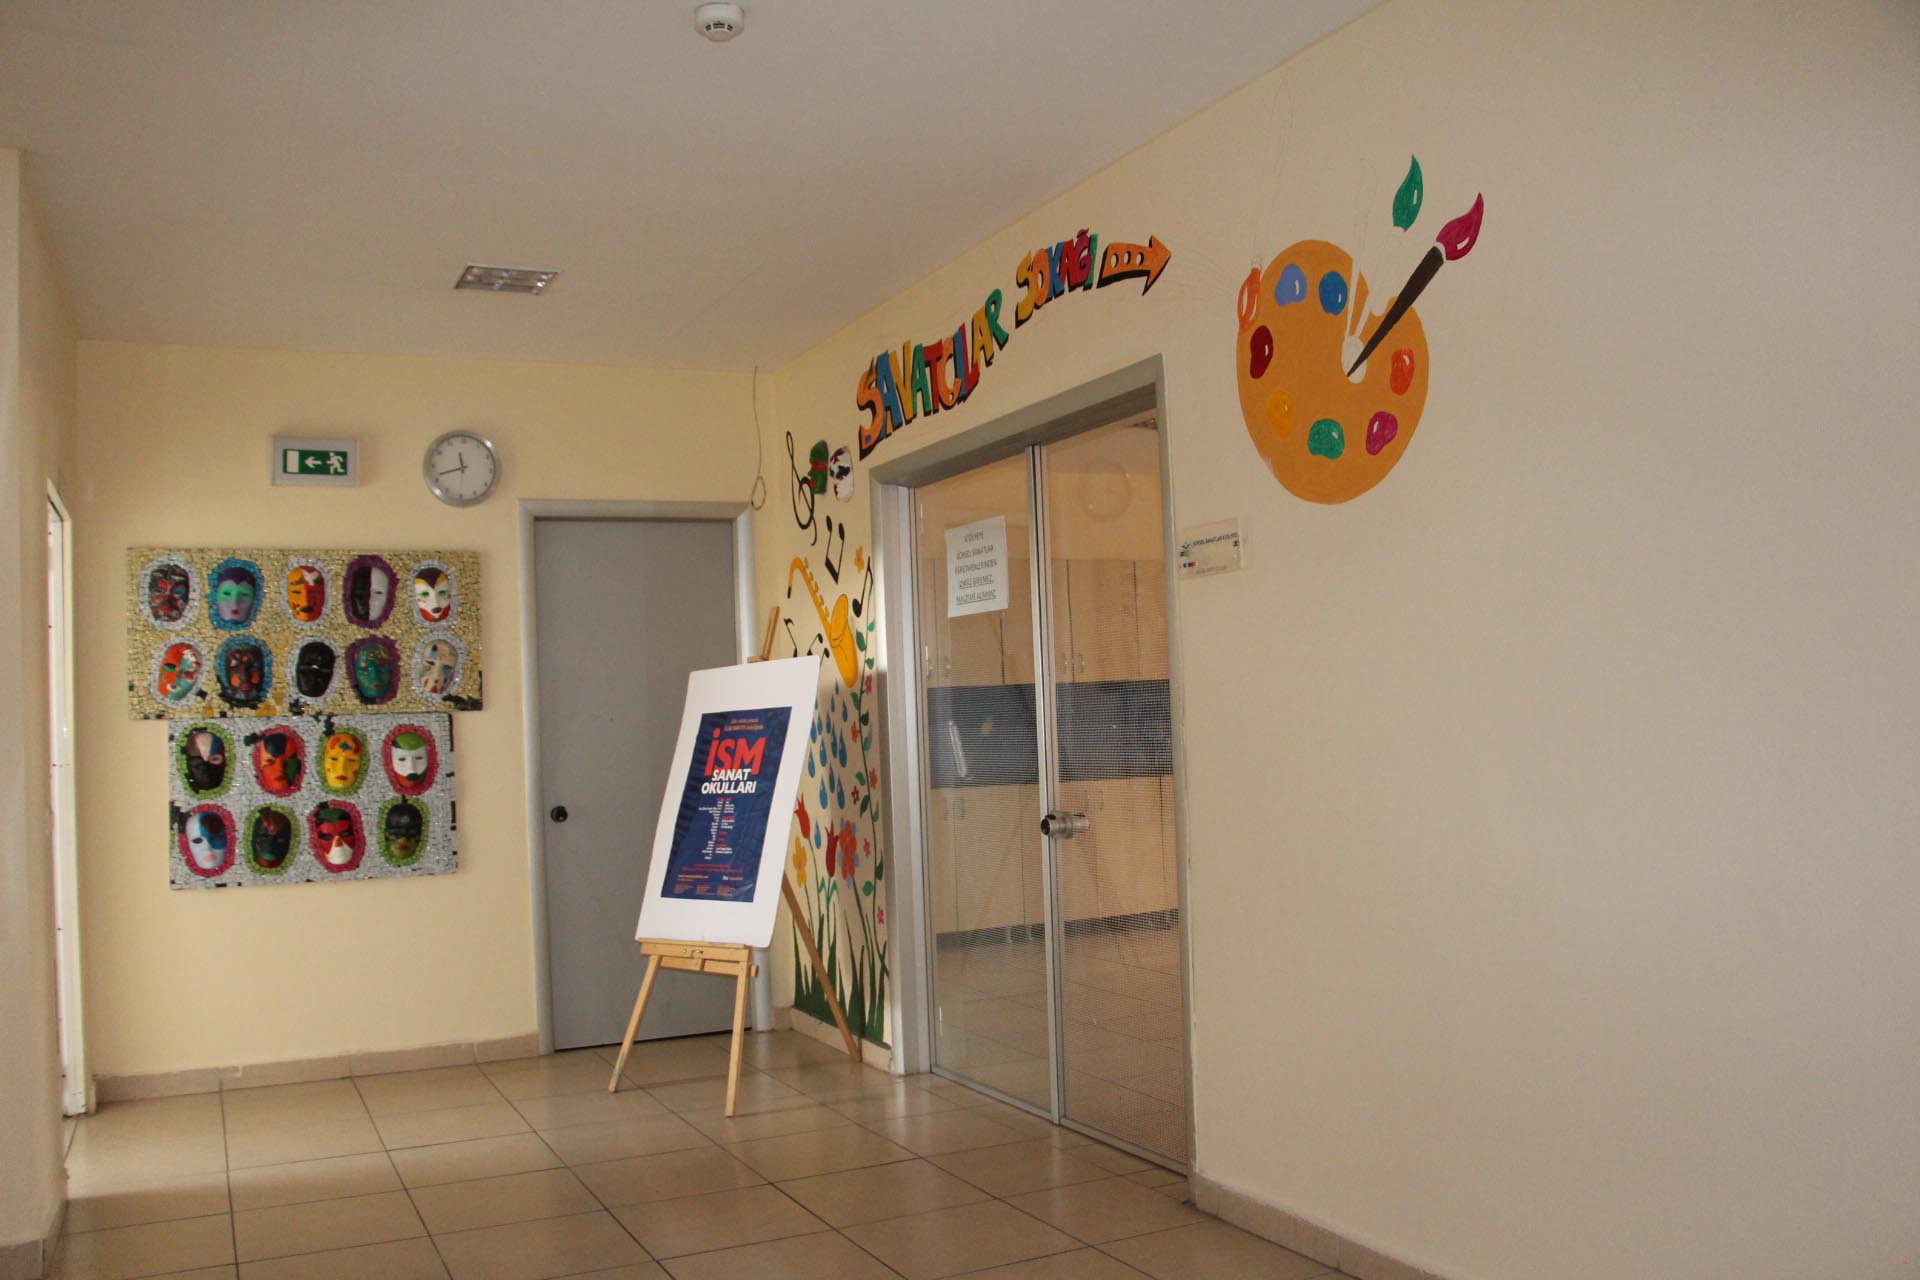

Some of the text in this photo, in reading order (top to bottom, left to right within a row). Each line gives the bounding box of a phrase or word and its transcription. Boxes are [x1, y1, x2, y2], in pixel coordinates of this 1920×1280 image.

[1015, 228, 1098, 329] SOKAĞI
[704, 728, 767, 776] İSM
[701, 781, 757, 795] OKULLARI
[711, 768, 751, 782] SANAT
